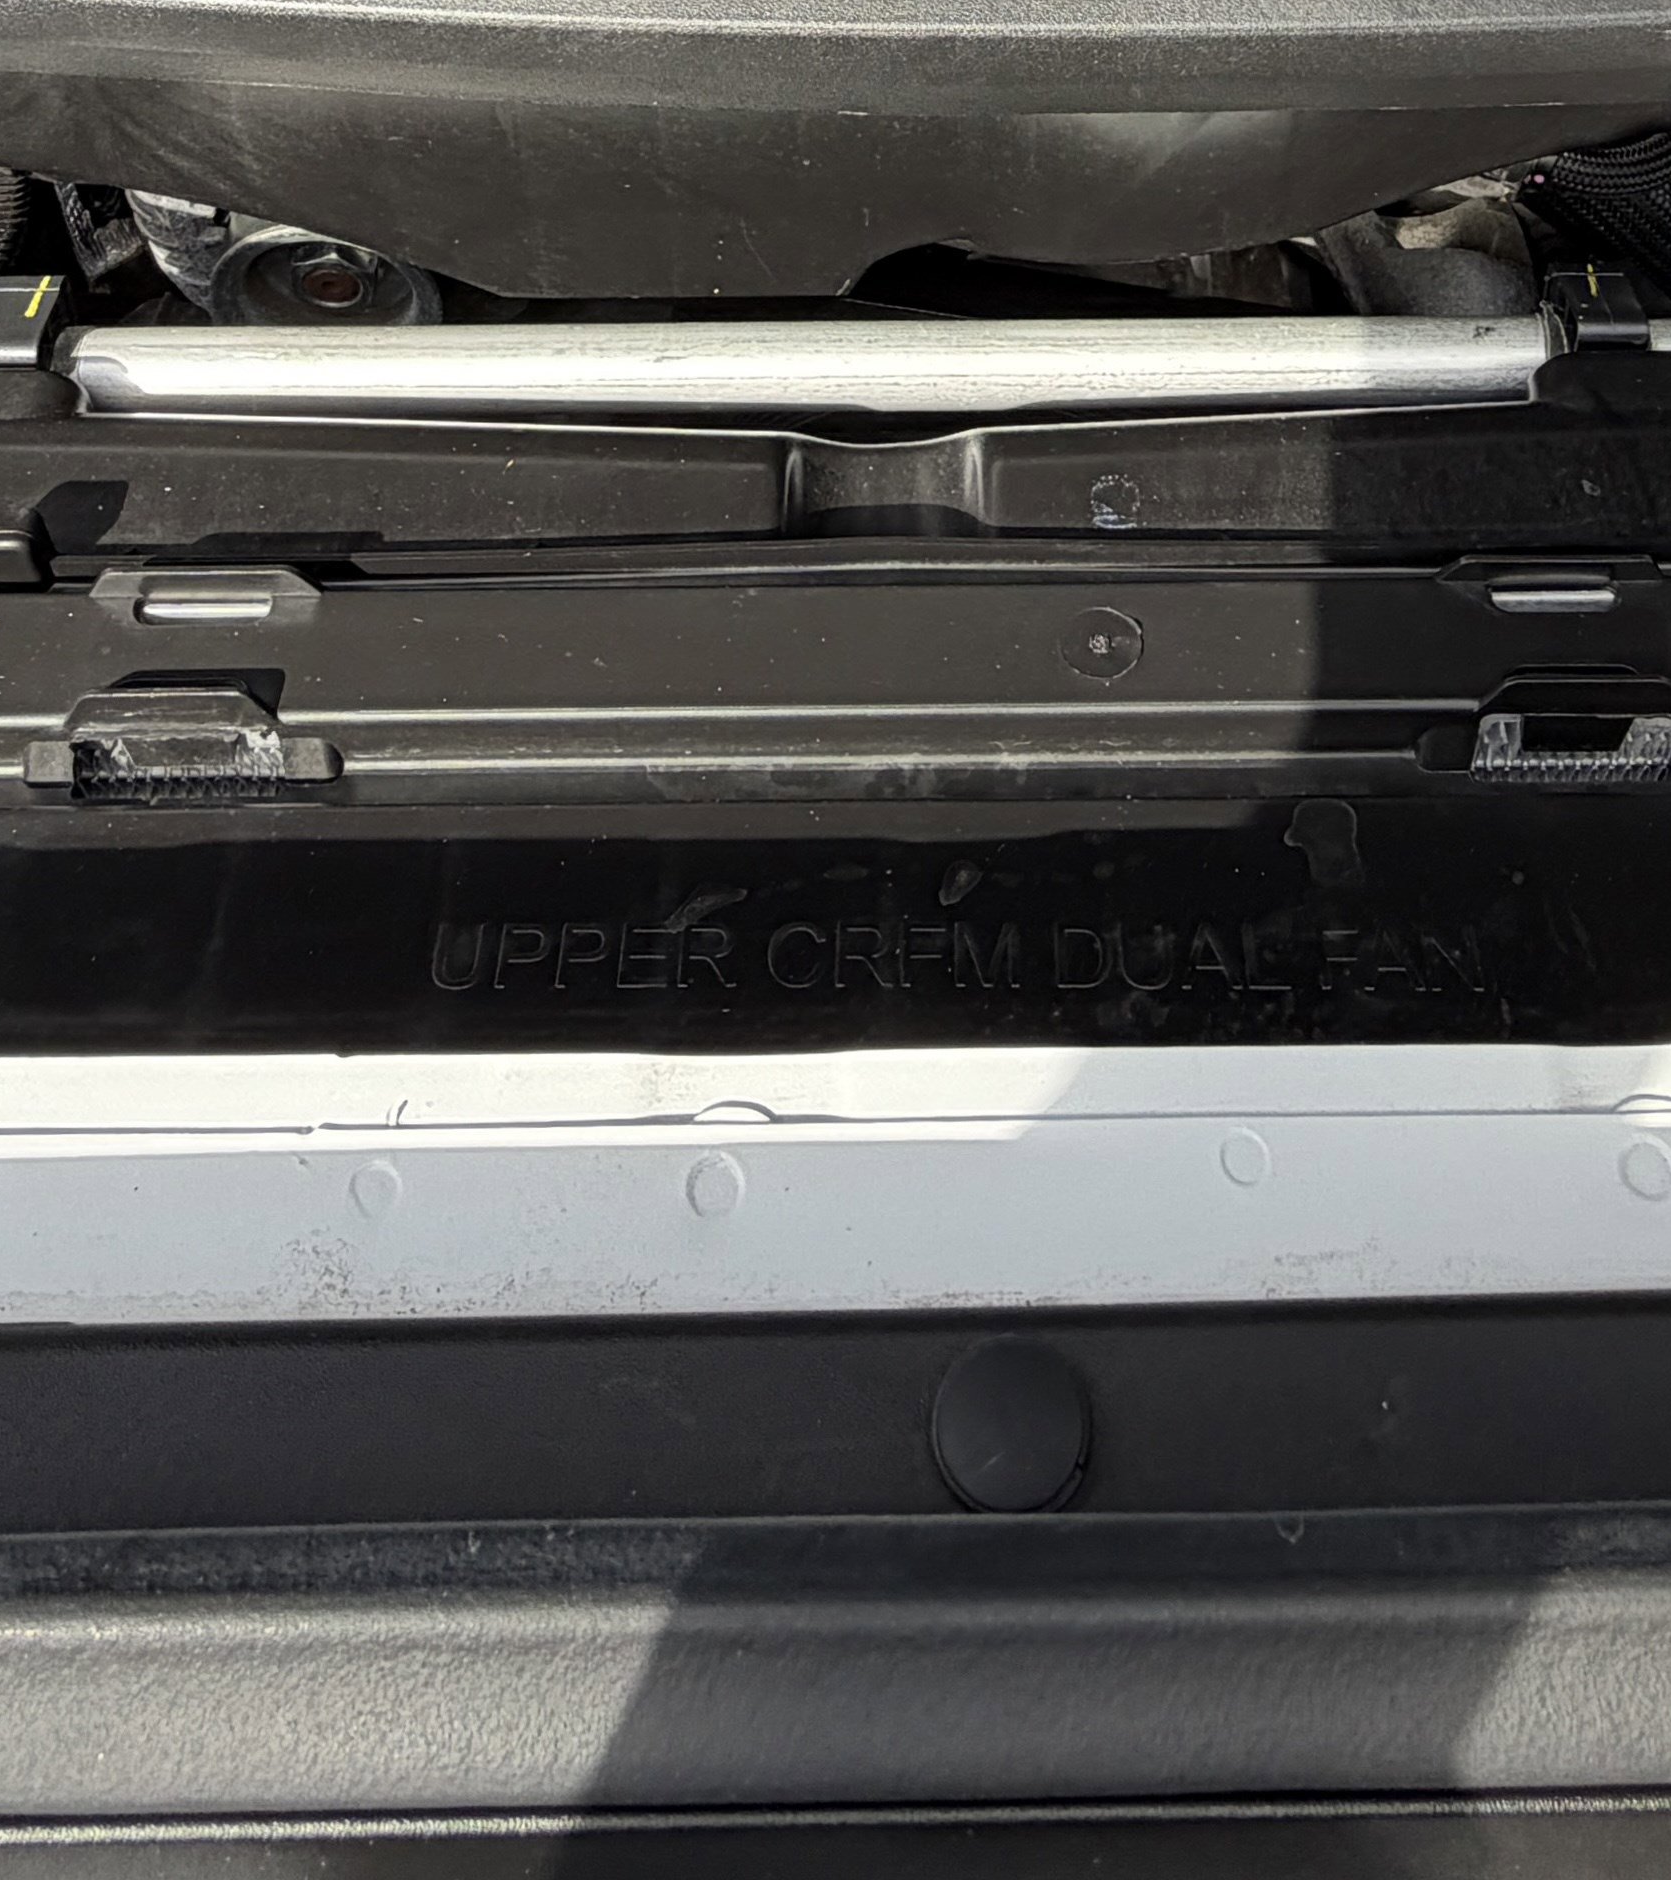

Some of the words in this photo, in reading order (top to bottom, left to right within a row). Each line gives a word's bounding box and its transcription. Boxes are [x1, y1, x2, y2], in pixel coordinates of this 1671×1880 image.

[430, 922, 737, 991] UPPER
[766, 922, 1022, 991] CRFM
[1052, 924, 1293, 992] DUAL
[1320, 928, 1487, 993] FAN
